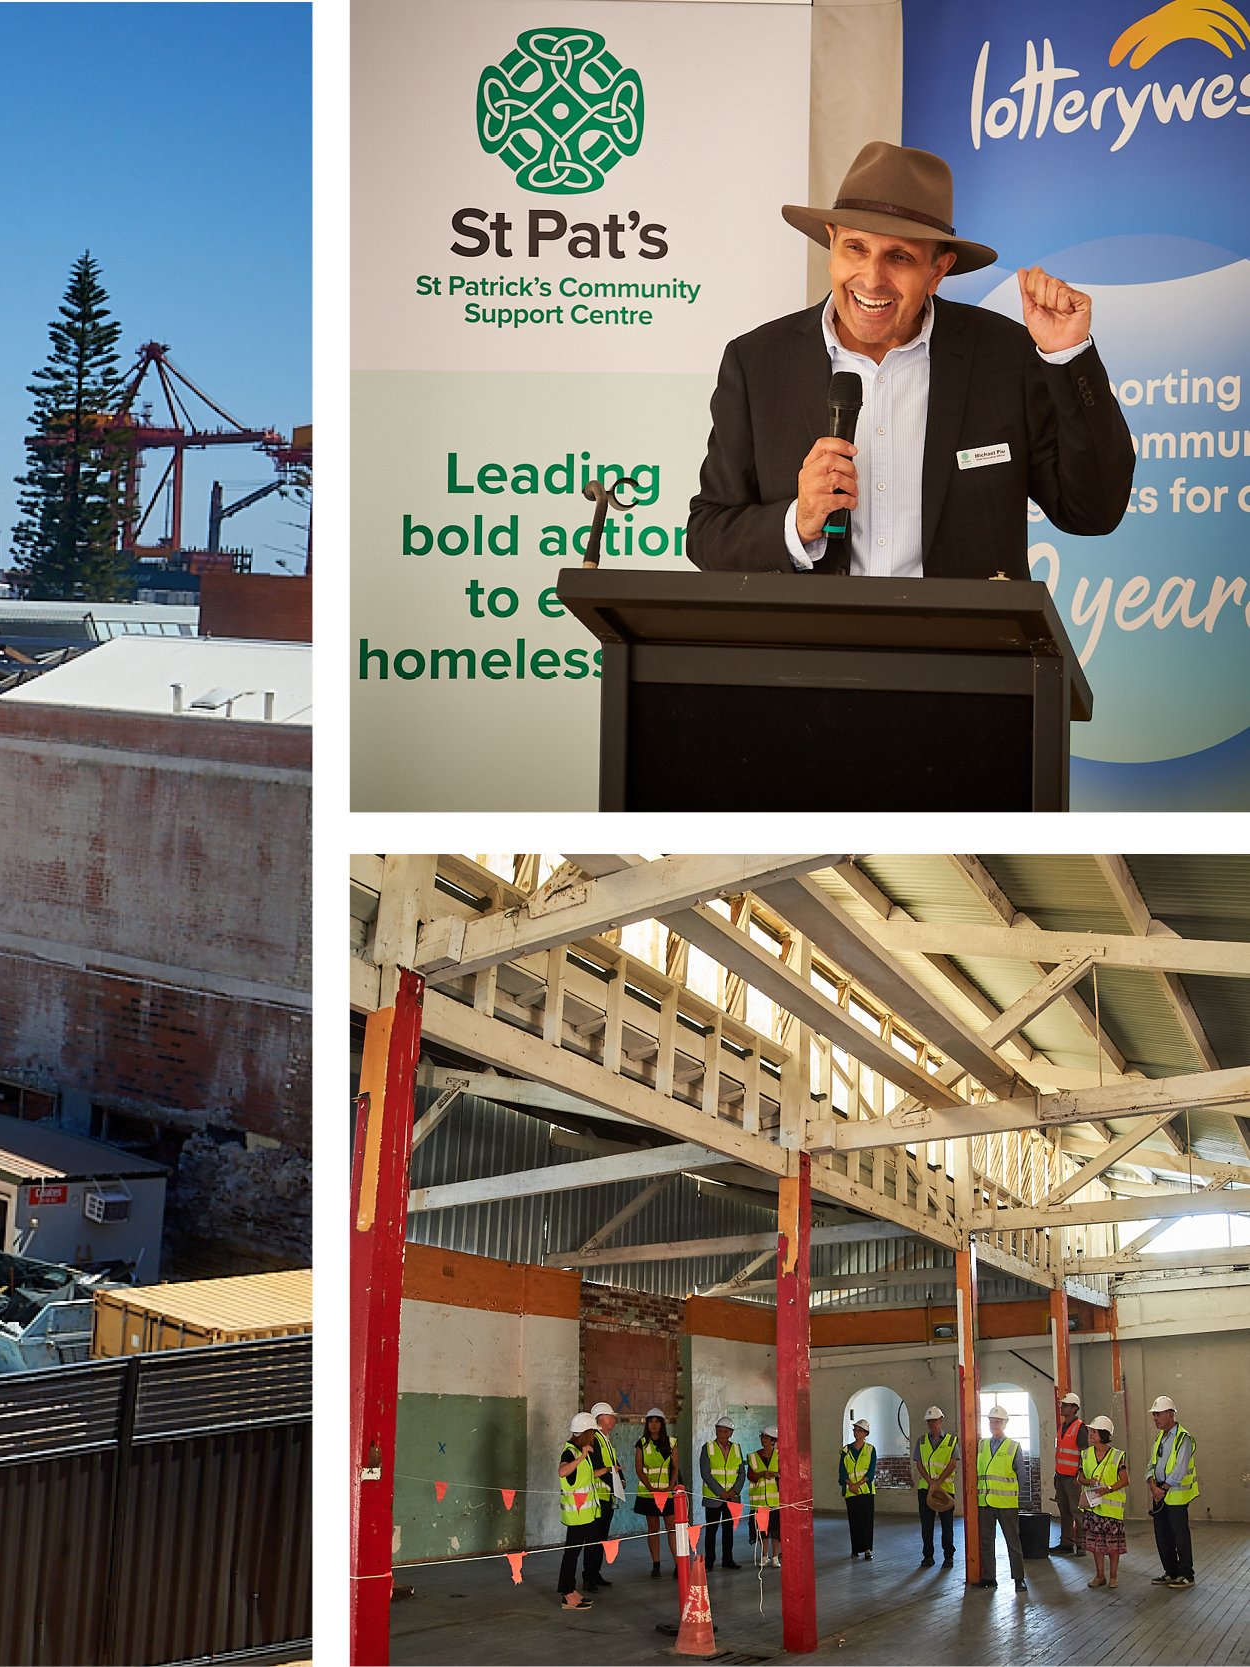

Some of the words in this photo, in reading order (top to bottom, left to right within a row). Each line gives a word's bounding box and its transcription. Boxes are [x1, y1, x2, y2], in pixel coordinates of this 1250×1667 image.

[451, 208, 512, 257] St
[529, 209, 668, 260] Pat’s
[416, 275, 441, 296] St
[449, 275, 551, 297] Patrick’s
[559, 277, 701, 306] Community
[464, 303, 563, 328] Support
[570, 303, 653, 325] Centre
[448, 452, 660, 506] Leading
[1169, 477, 1229, 513] for
[403, 514, 518, 556] bold
[465, 579, 519, 618] to
[1070, 575, 1250, 669] year
